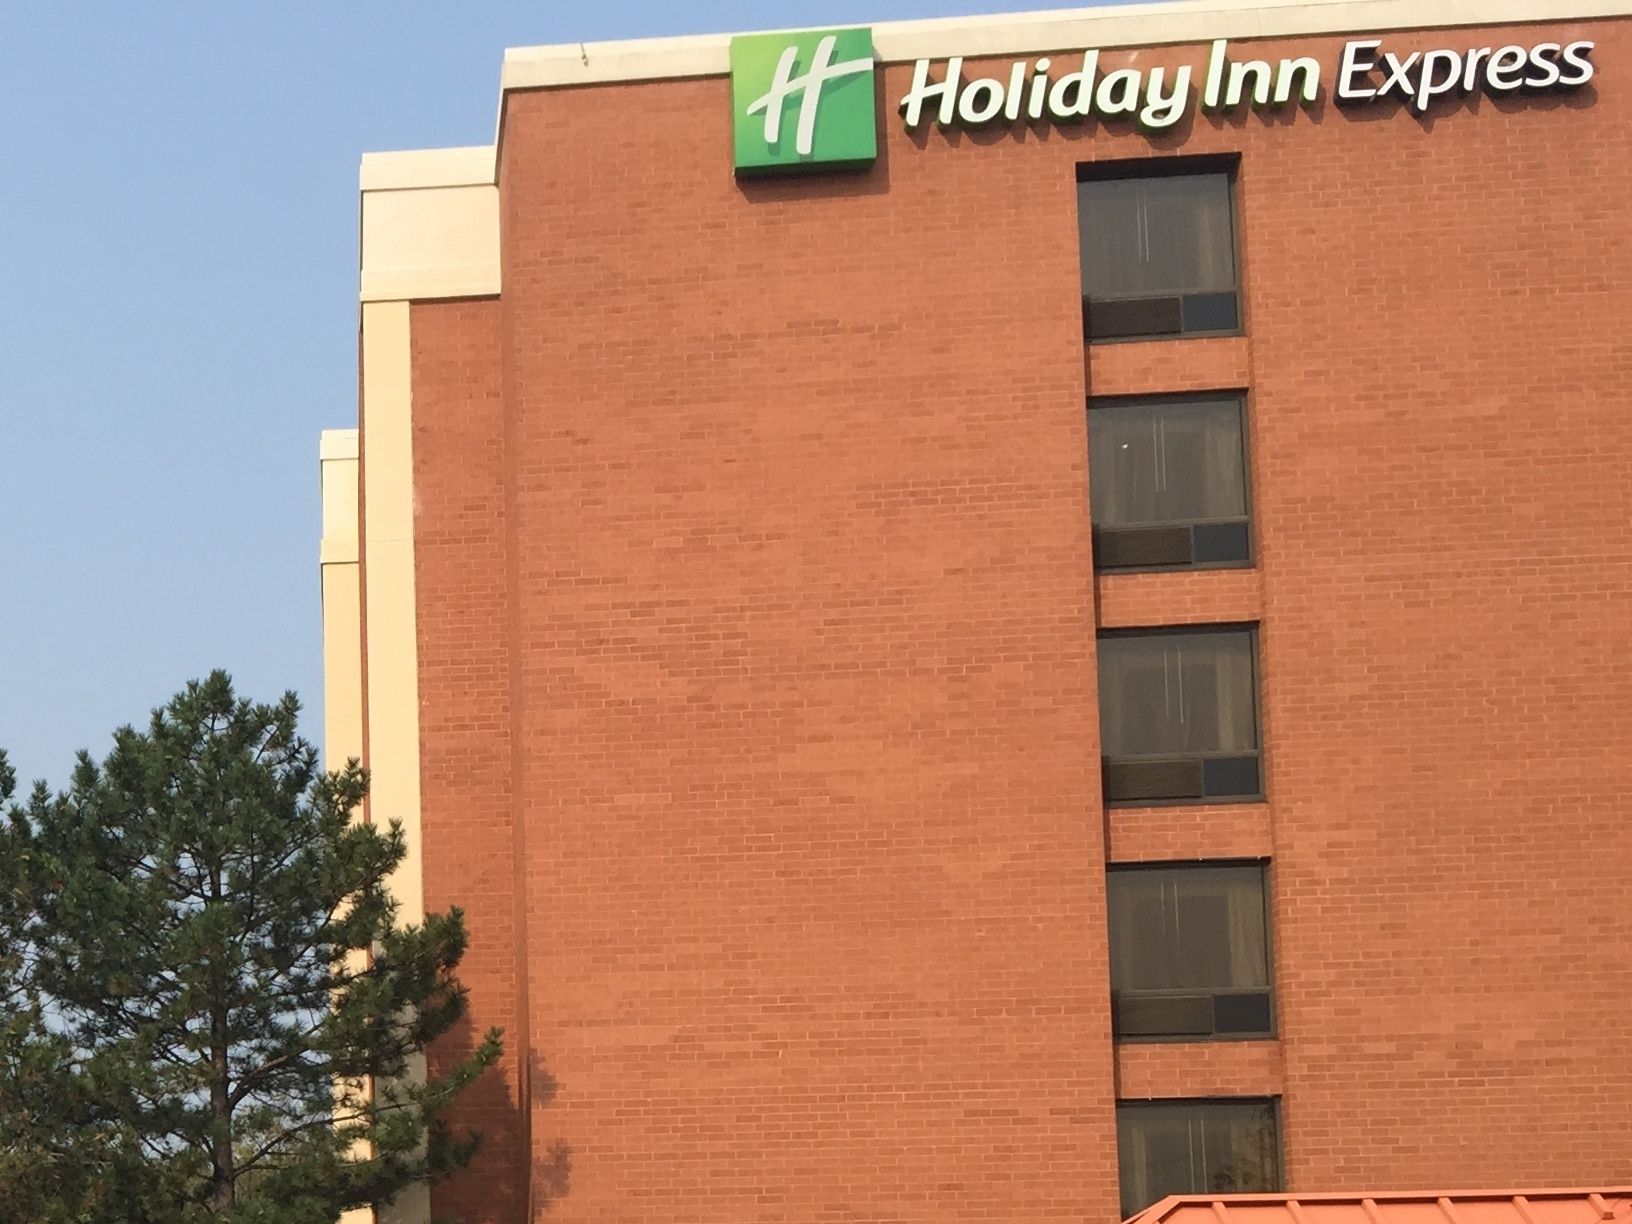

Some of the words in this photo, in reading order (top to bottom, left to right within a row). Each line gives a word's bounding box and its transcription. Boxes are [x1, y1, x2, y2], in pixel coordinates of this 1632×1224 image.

[747, 35, 874, 155] H
[899, 48, 1193, 129] Holiday
[1204, 38, 1321, 108] Inn
[1338, 39, 1596, 112] Express
